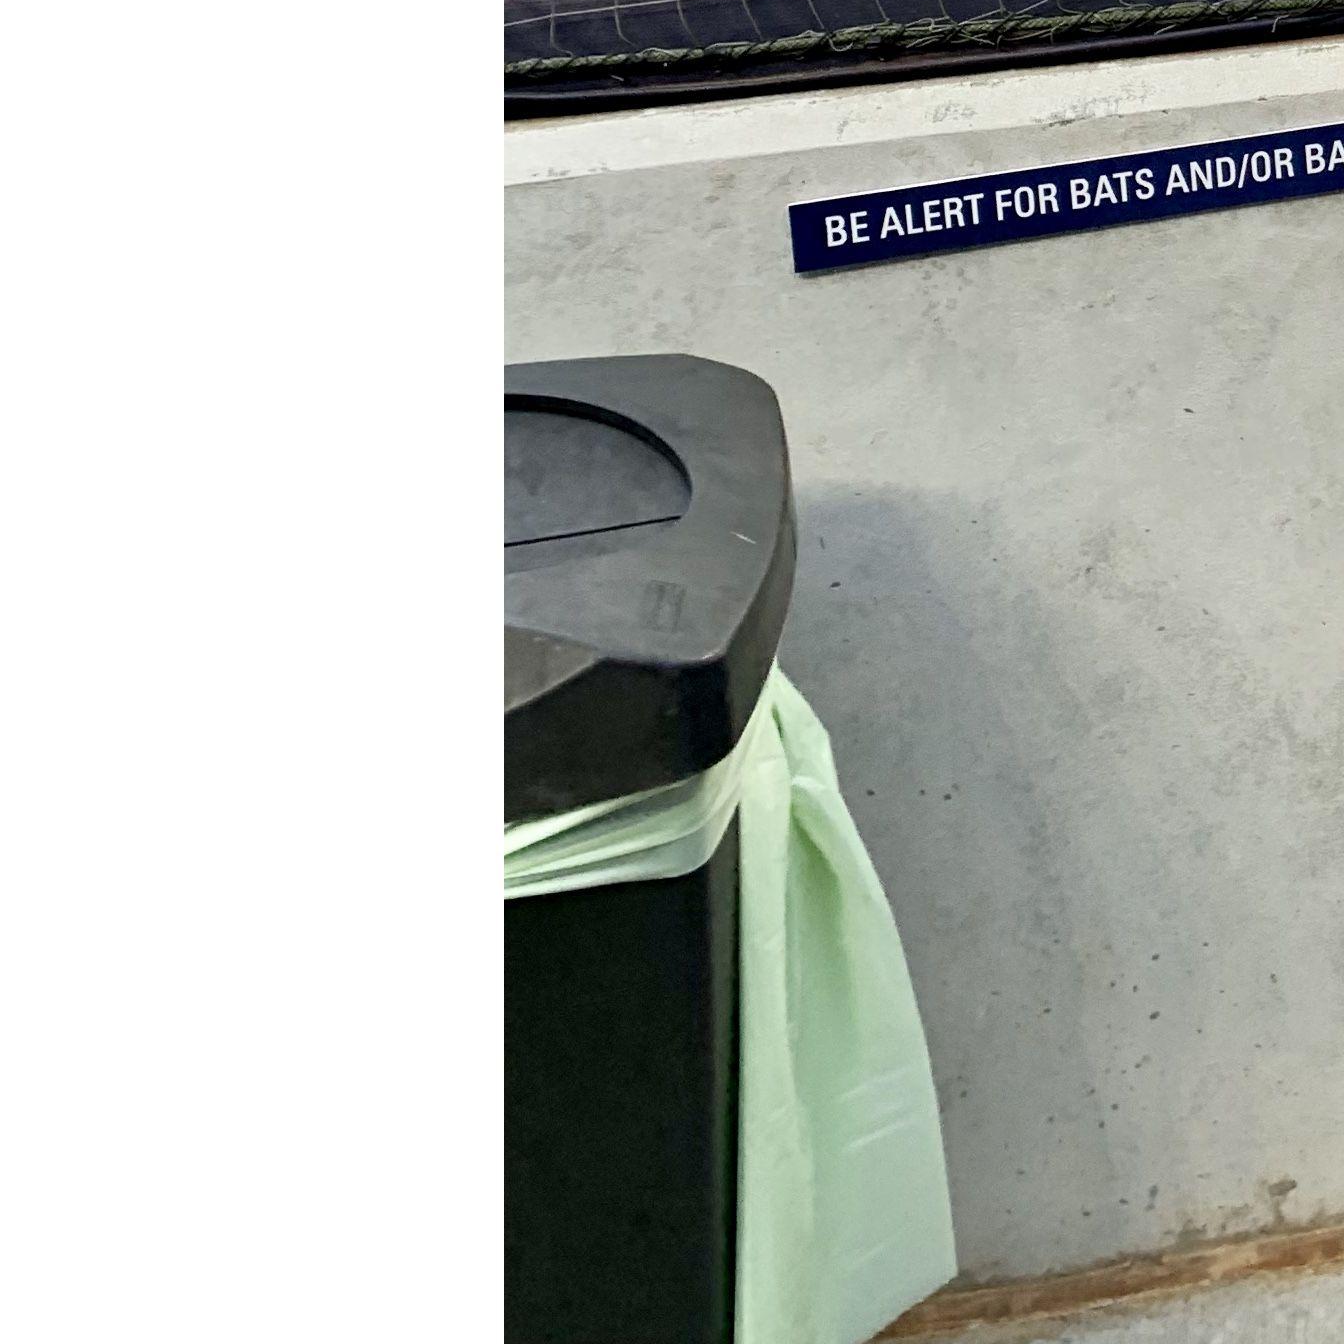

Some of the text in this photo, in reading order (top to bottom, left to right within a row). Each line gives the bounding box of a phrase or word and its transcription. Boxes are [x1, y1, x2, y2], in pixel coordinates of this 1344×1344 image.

[825, 210, 871, 248] BE
[879, 192, 981, 240] ALERT
[995, 181, 1061, 223] FOR
[1070, 168, 1156, 211] BATS
[1165, 146, 1296, 197] AND/OR
